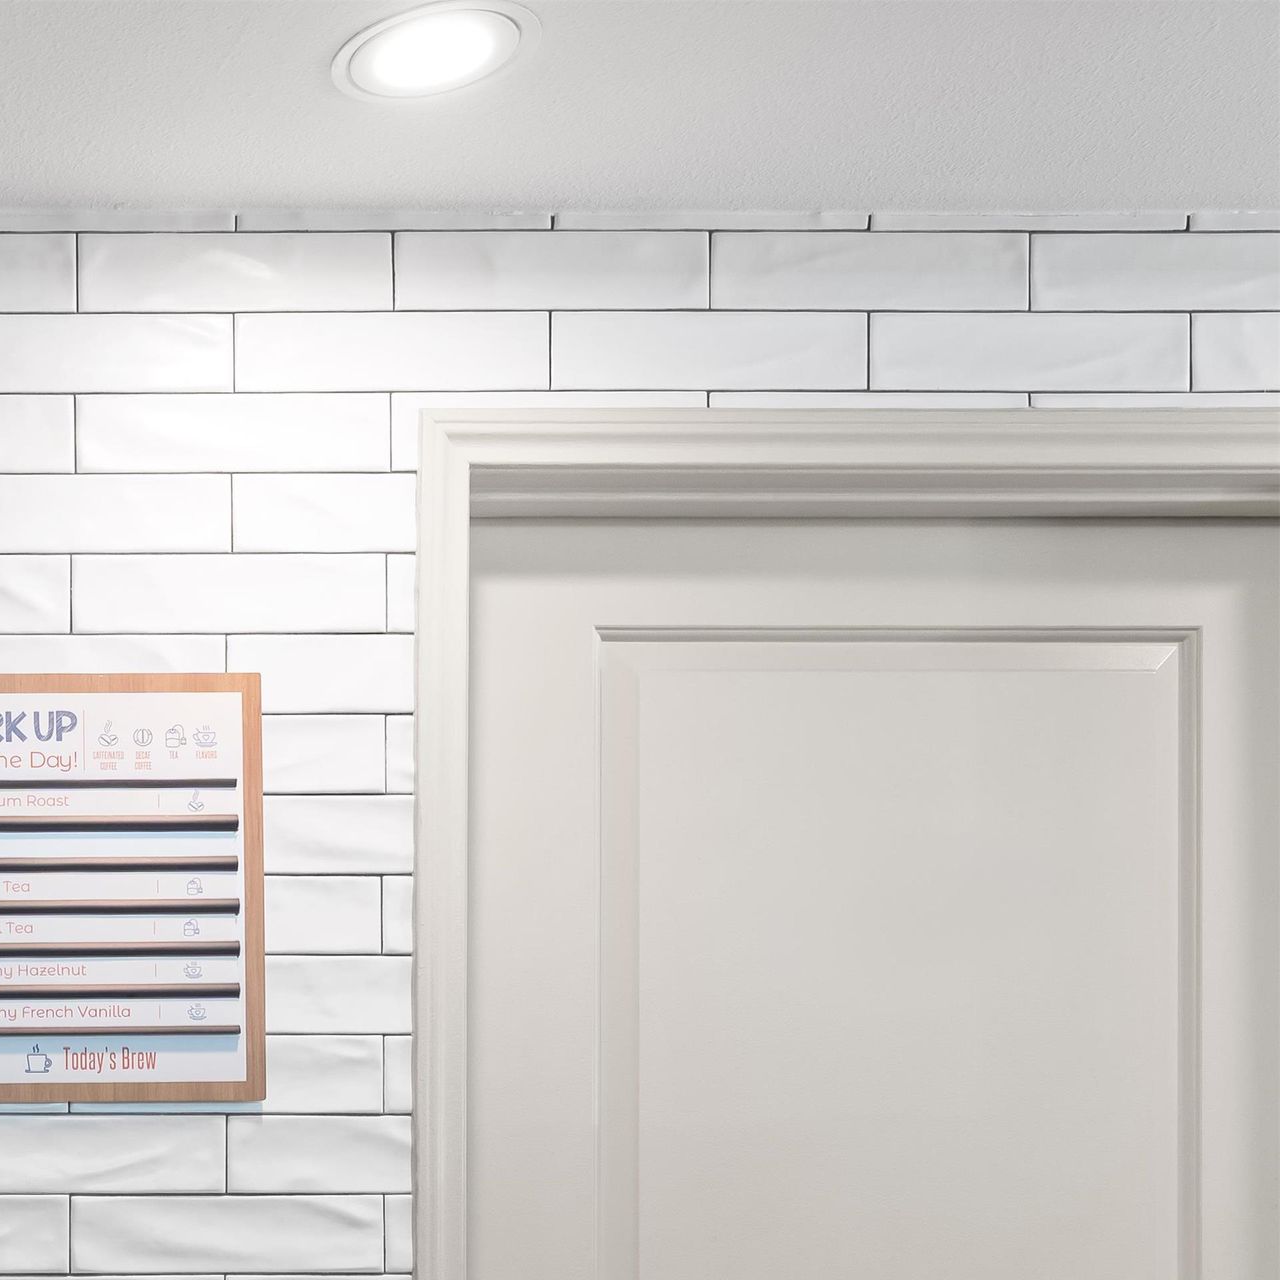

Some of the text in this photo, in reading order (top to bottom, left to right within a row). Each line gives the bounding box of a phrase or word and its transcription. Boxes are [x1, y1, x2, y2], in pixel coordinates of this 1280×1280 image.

[33, 710, 78, 742] UP
[169, 750, 179, 759] TEA
[195, 750, 218, 759] FLAVORS
[30, 751, 78, 773] Day!
[27, 794, 70, 807] Roast
[2, 880, 31, 893] Tea
[6, 921, 33, 934] Tea
[17, 963, 87, 977] Hazelnut
[22, 1005, 74, 1019] French
[77, 1005, 131, 1018] Vanilla
[63, 1047, 157, 1074] Today's Brew
